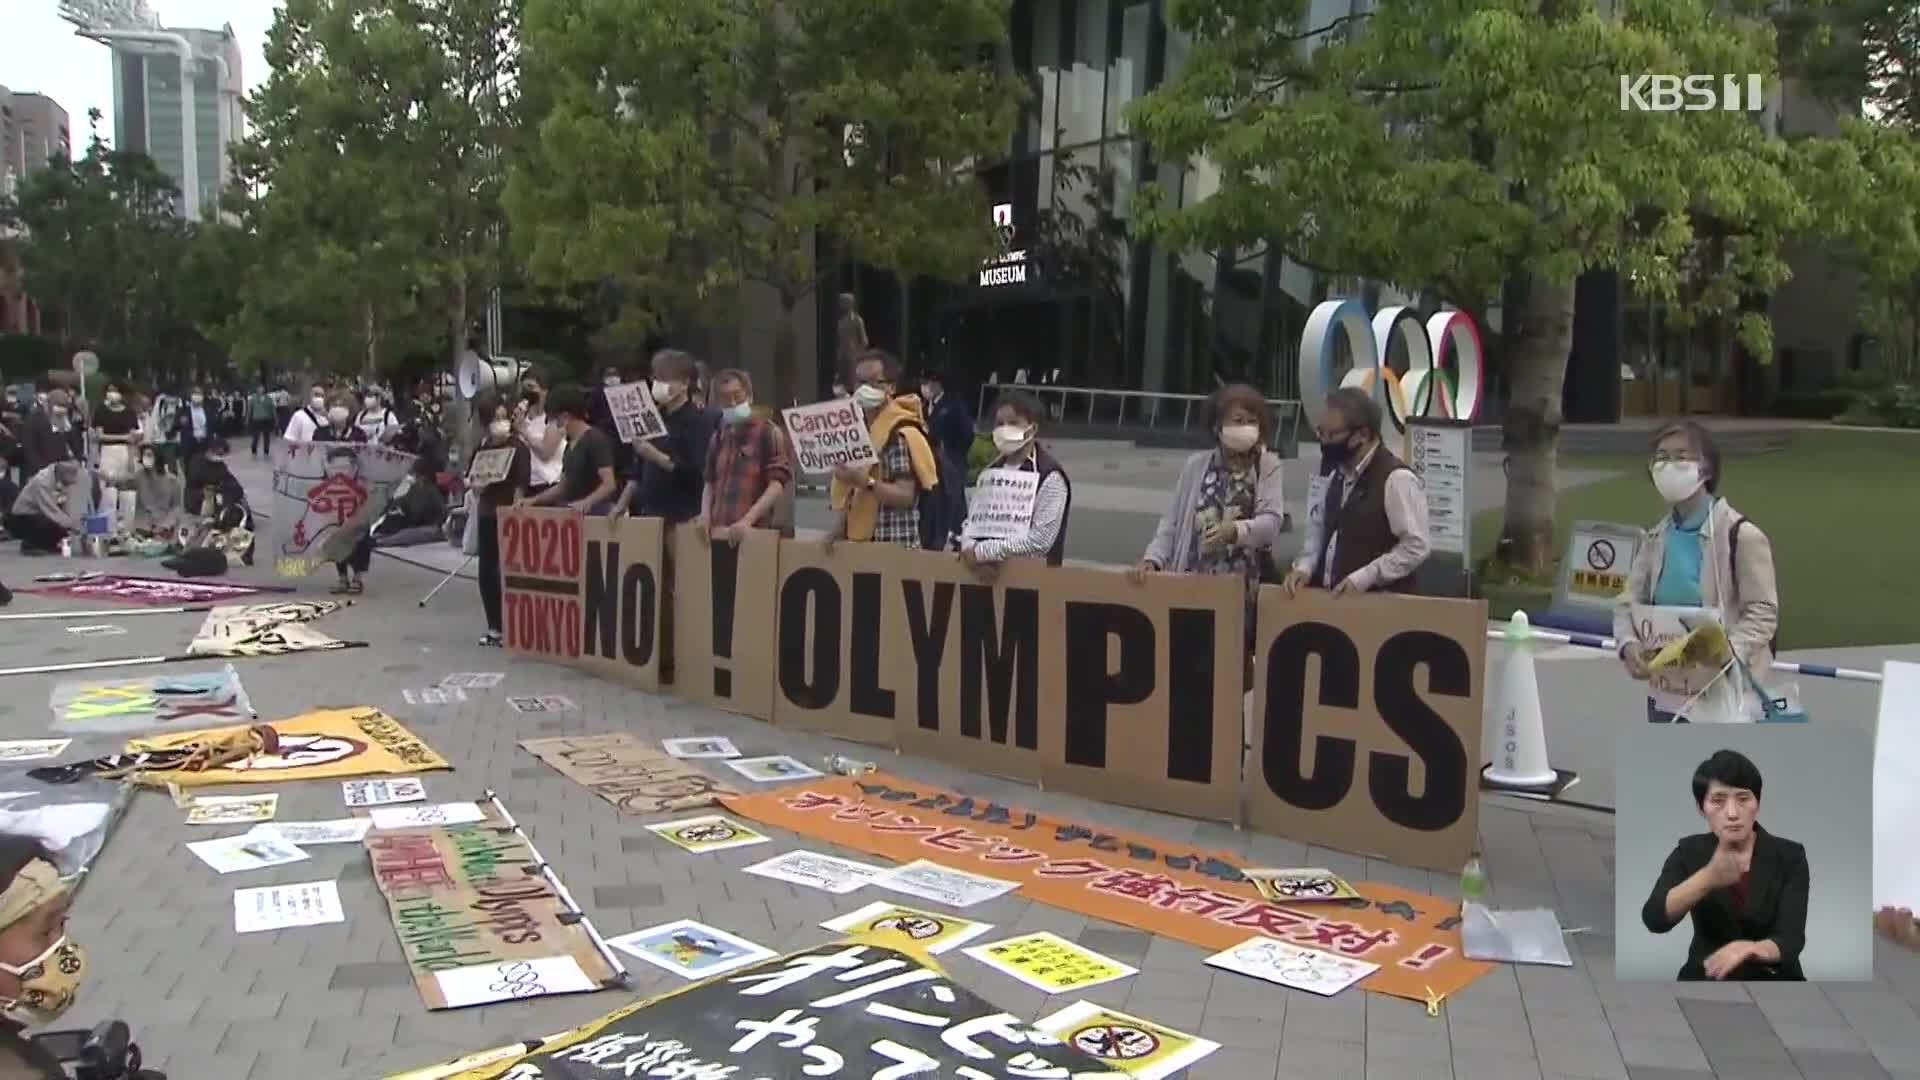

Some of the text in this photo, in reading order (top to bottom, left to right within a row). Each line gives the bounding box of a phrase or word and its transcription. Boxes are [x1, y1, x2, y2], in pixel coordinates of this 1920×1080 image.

[980, 265, 1026, 286] MUSEUM
[789, 402, 859, 433] Cancel
[815, 428, 860, 447] TOKYO
[800, 443, 872, 469] Olympics
[503, 518, 580, 577] 2020
[505, 591, 580, 659] TOKYO
[778, 566, 1471, 831] OLYMPICS
